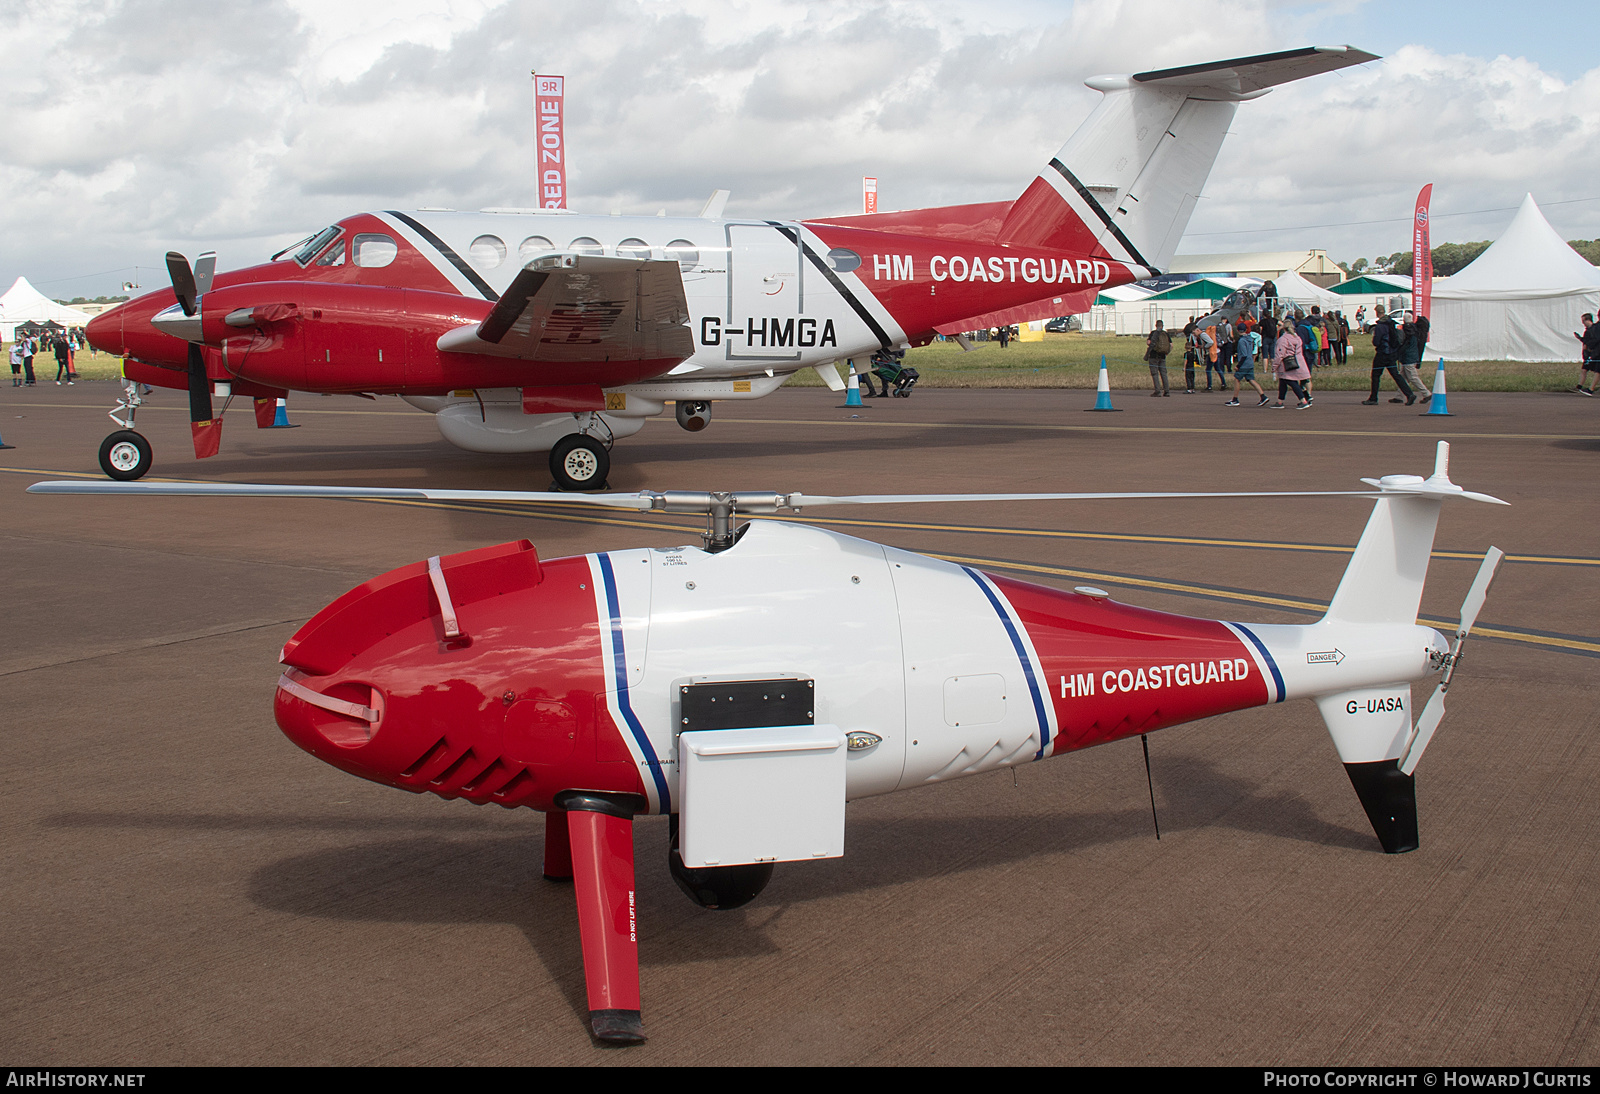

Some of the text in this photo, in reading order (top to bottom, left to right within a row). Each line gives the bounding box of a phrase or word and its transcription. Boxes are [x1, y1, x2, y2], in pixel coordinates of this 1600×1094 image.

[542, 82, 558, 92] 9R
[541, 101, 562, 209] RED ZONE
[873, 254, 1110, 284] HM COASTGUARD
[701, 316, 837, 347] G-HMGA
[1060, 658, 1249, 698] HM COASTGUARD
[1346, 696, 1404, 714] G-UASA
[630, 932, 636, 942] DO
